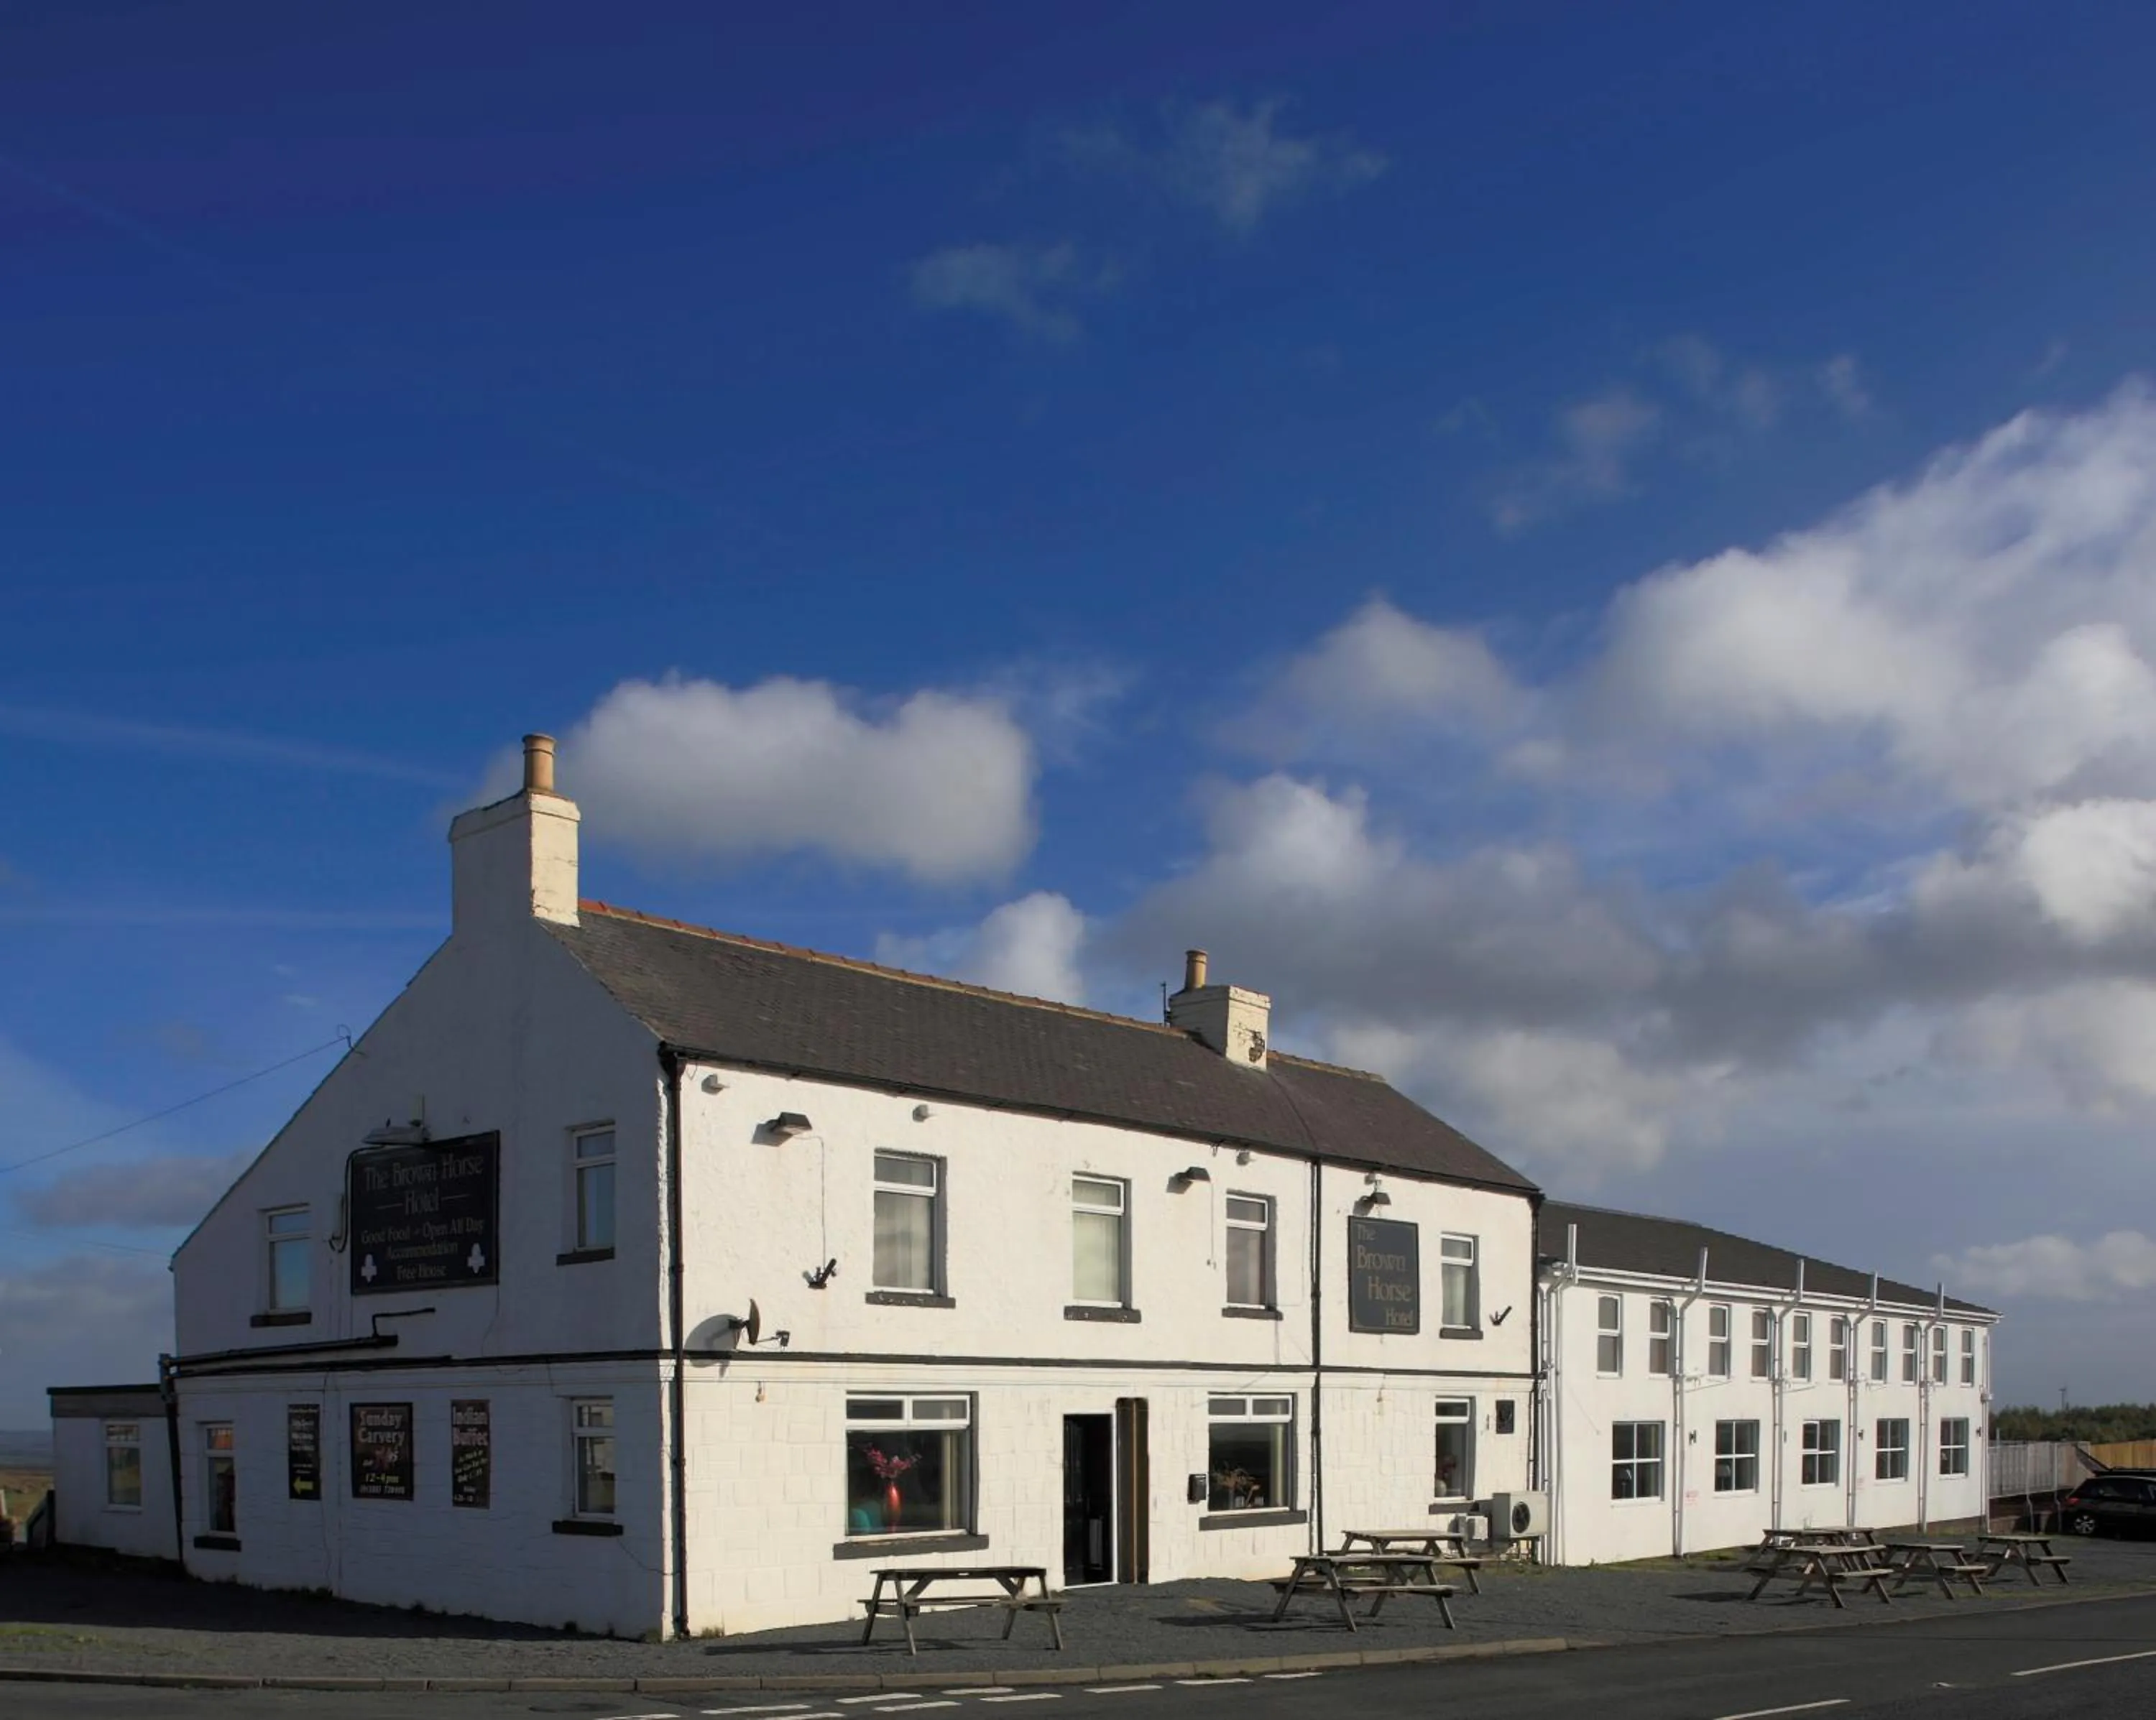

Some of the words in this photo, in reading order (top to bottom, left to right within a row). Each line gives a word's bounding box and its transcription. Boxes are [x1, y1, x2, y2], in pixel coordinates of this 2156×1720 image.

[364, 1166, 389, 1192] The
[392, 1162, 438, 1187] Brown
[441, 1152, 484, 1180] Horse
[404, 1186, 440, 1216] Hotel
[361, 1229, 387, 1244] Good
[388, 1224, 411, 1242] Food
[422, 1221, 448, 1240] Open
[450, 1217, 464, 1235] All
[465, 1216, 484, 1235] Day
[1357, 1224, 1376, 1241] The
[1356, 1244, 1407, 1272] Brown
[396, 1264, 415, 1282] Free
[418, 1262, 448, 1279] House
[1368, 1275, 1412, 1302] Horse
[1385, 1306, 1414, 1326] Hotel
[359, 1408, 403, 1429] Sunday
[358, 1427, 405, 1446] Carvery
